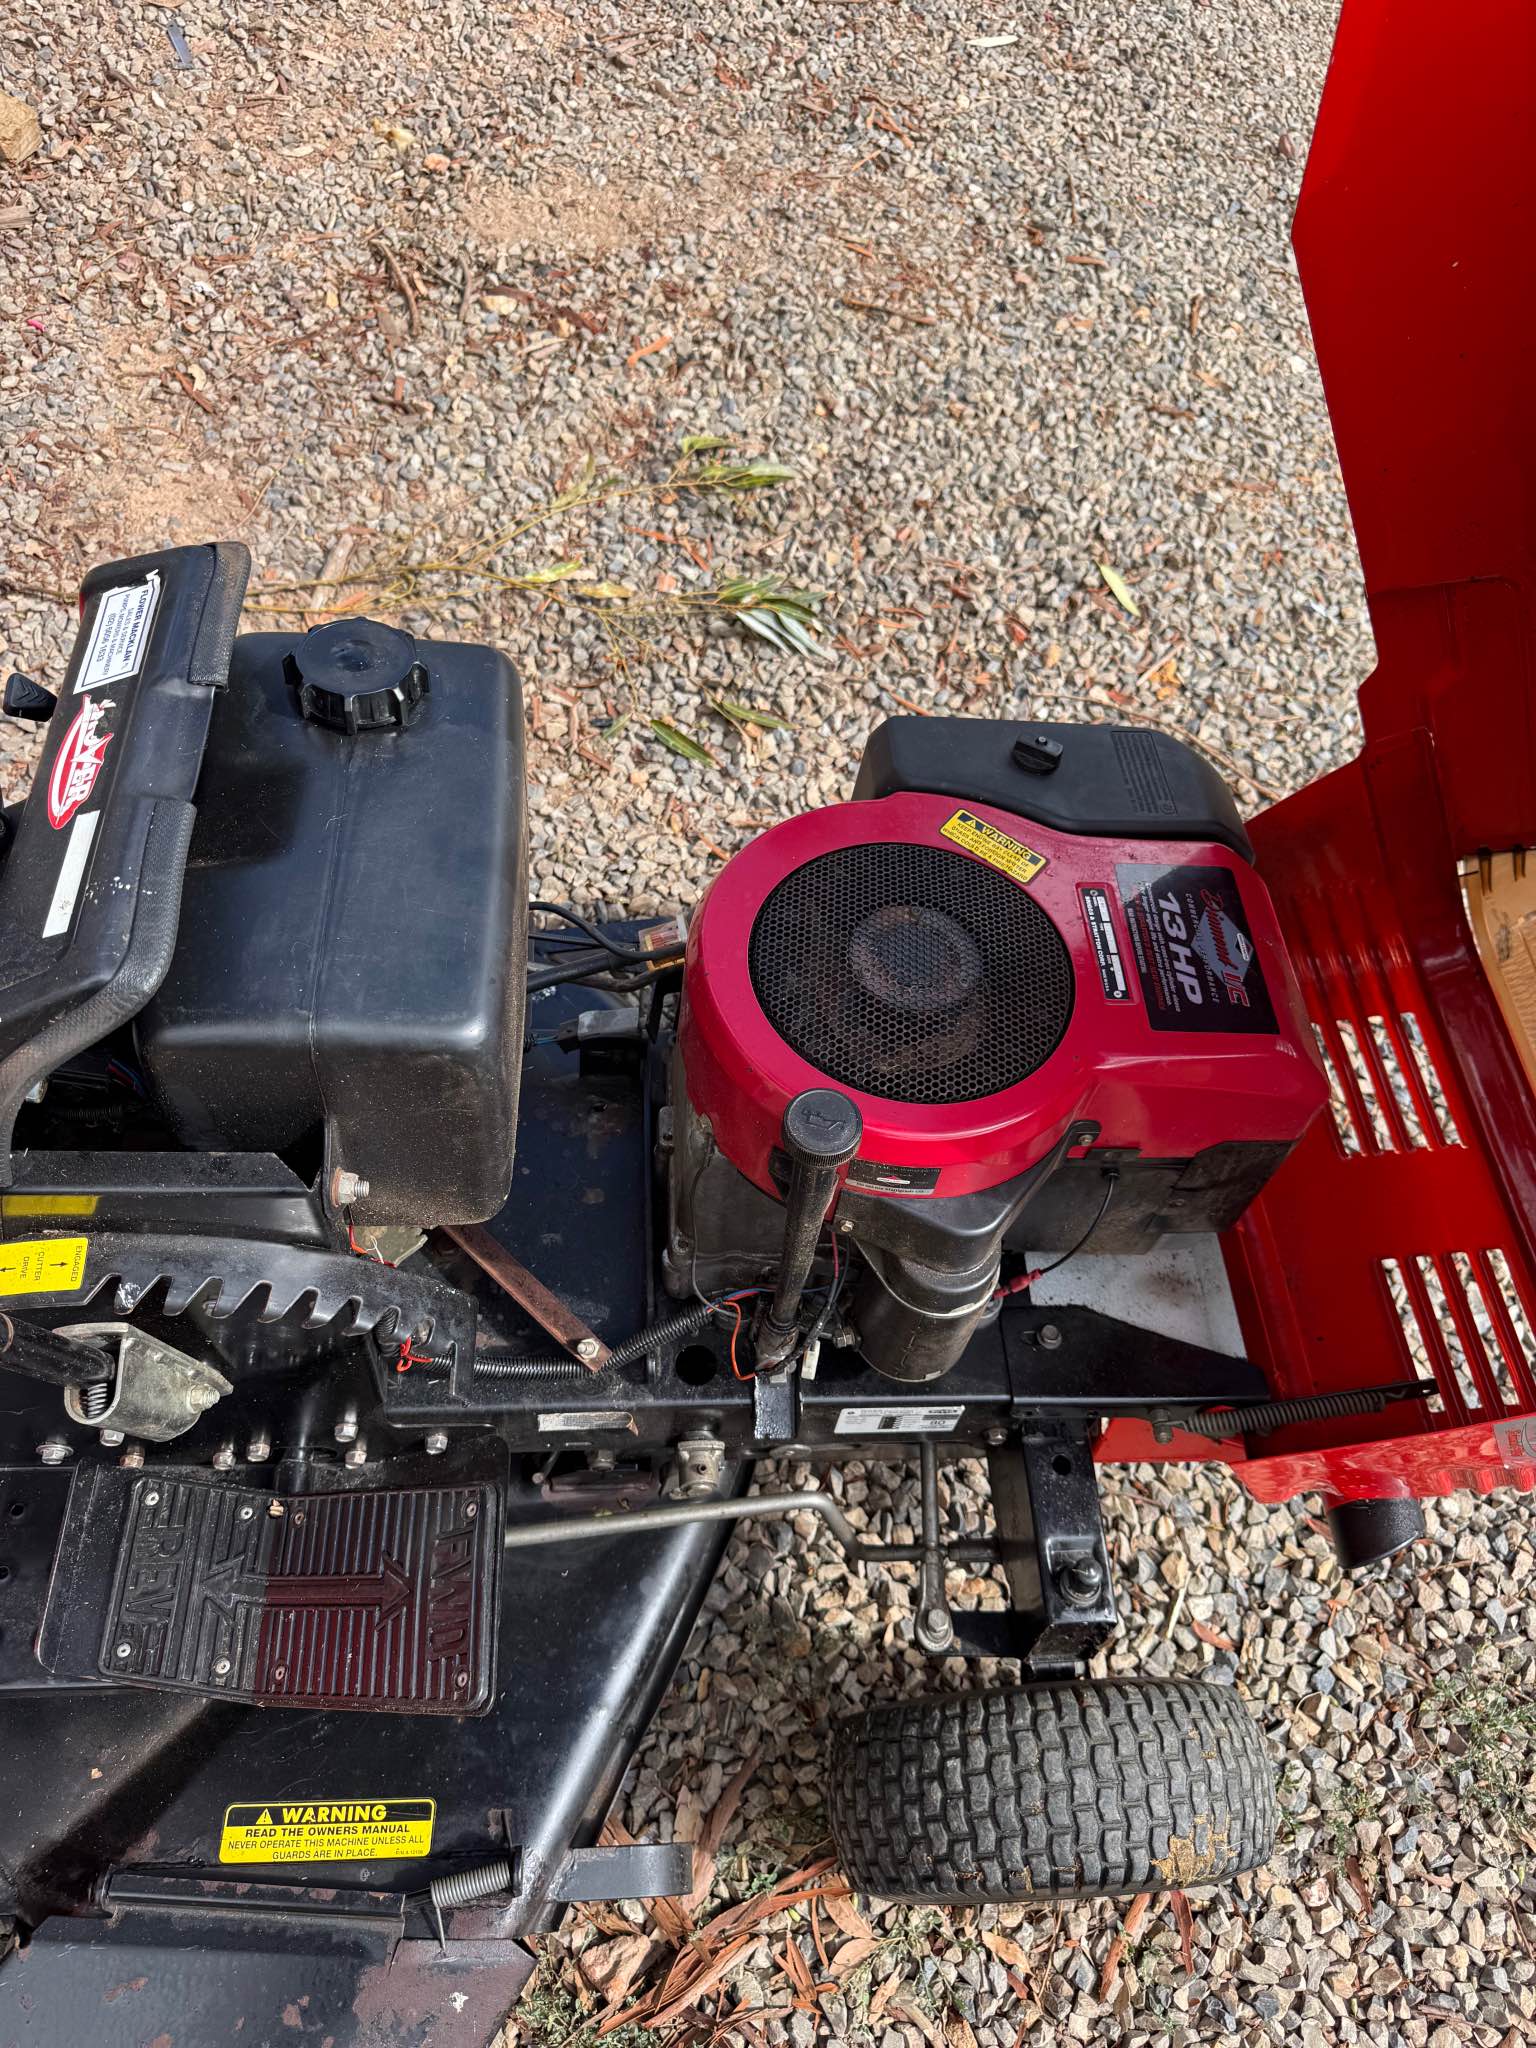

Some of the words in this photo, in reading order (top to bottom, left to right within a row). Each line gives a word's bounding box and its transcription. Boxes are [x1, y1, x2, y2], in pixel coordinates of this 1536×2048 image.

[123, 608, 134, 624] SALES
[133, 589, 149, 620] FLOWER
[115, 630, 127, 655] SERVICE
[122, 622, 140, 661] MACKLAN
[950, 825, 971, 839] GRASS
[969, 837, 981, 845] AND
[980, 843, 1005, 860] FOREIGN
[1005, 858, 1027, 873] MATTER
[956, 822, 972, 833] KEEP
[970, 831, 992, 845] ENGINE
[1002, 849, 1021, 862] CLEAR
[979, 826, 1033, 860] WARNING
[959, 838, 979, 851] COULD
[1004, 865, 1028, 880] HAZARD
[1084, 895, 1093, 915] BRIGGS
[1090, 921, 1102, 949] STRATTON
[19, 1256, 29, 1278] DRIVE
[33, 1251, 44, 1280] CUTTER
[69, 1245, 83, 1281] ENGAGED
[281, 1804, 388, 1824] WARNING
[228, 1840, 257, 1849] NEVER
[259, 1839, 301, 1848] OPERATE
[304, 1838, 324, 1847] THIS
[326, 1837, 369, 1846] MACHINE
[371, 1835, 406, 1844] UNLESS
[408, 1835, 423, 1843] ALL
[245, 1828, 276, 1838] READ
[281, 1828, 302, 1837] THE
[307, 1826, 357, 1836] OWNERS
[362, 1824, 410, 1834] MANUAL
[271, 1850, 310, 1860] GUARDS
[312, 1850, 331, 1859] ARE
[334, 1849, 343, 1858] IN
[346, 1848, 377, 1857] PLACE.
